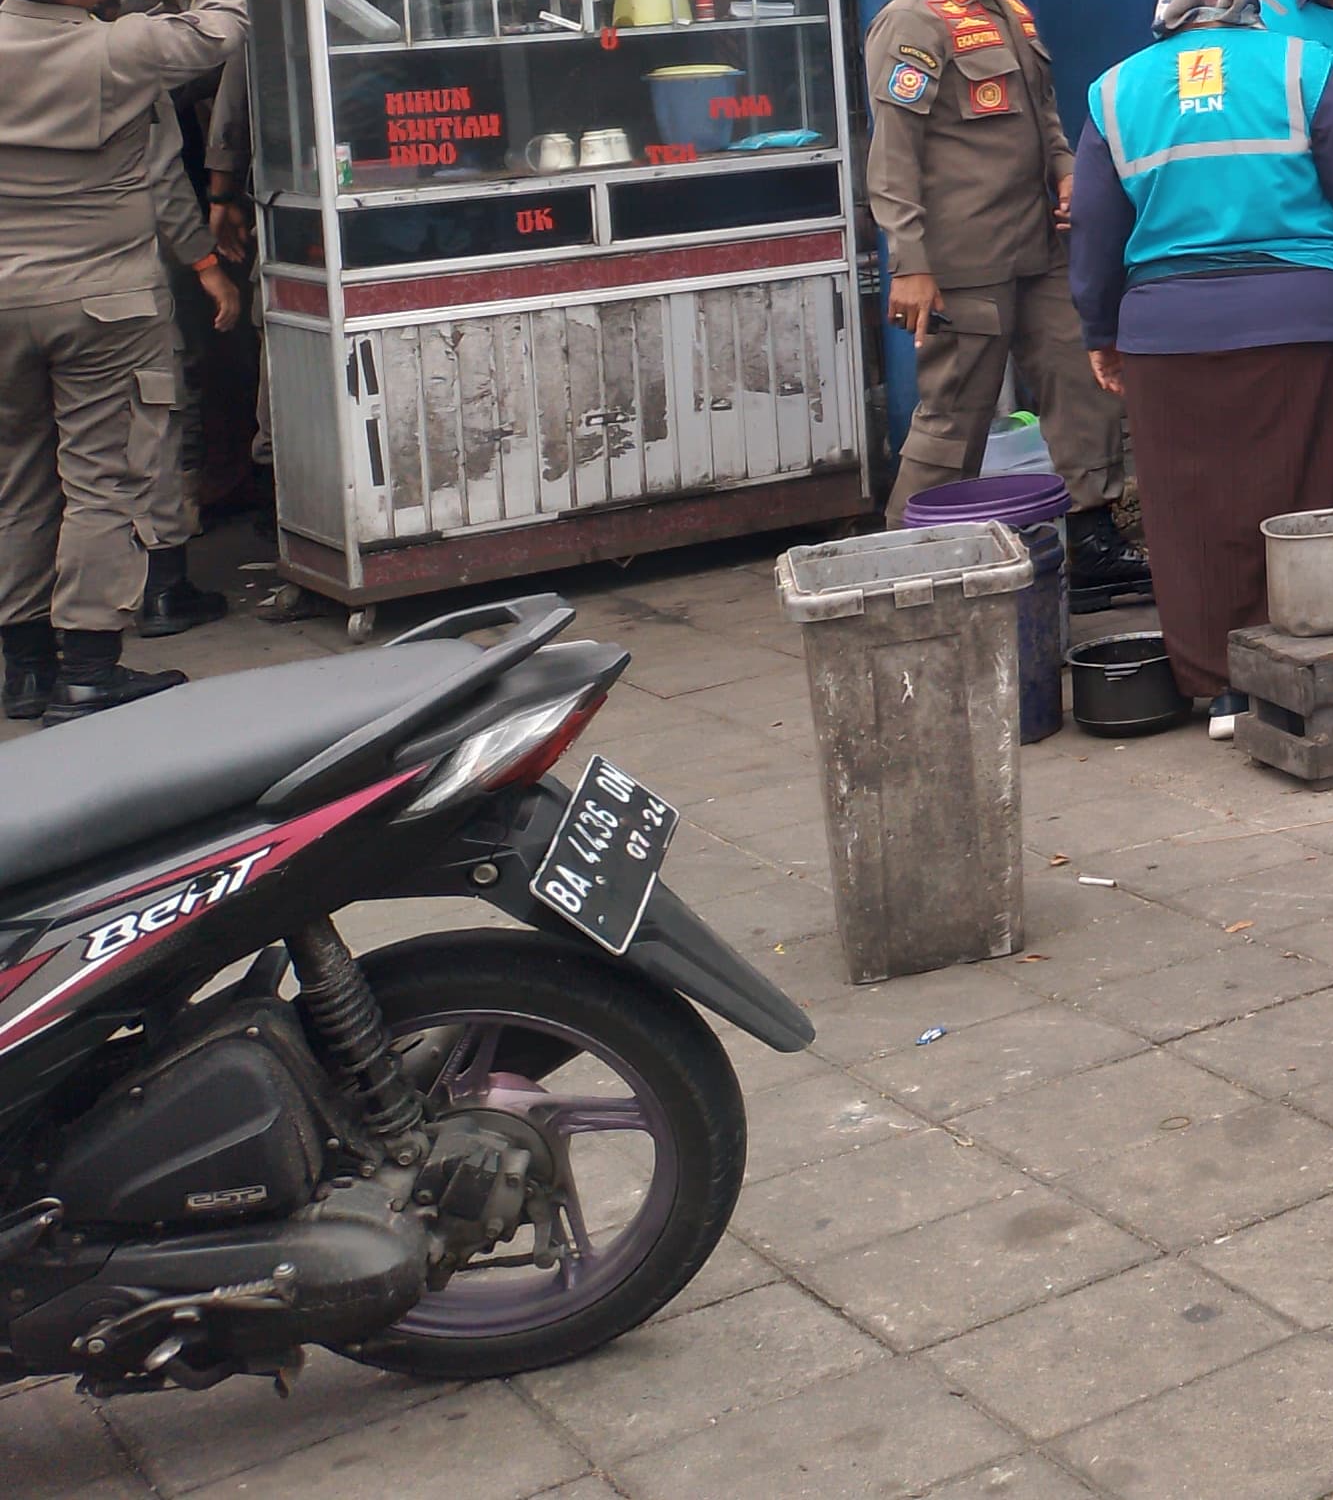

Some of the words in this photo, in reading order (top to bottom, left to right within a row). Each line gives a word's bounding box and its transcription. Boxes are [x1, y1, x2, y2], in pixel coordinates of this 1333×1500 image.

[1180, 95, 1223, 114] PLN
[389, 142, 457, 168] INDO
[568, 800, 619, 864] 4436
[545, 865, 593, 913] BA
